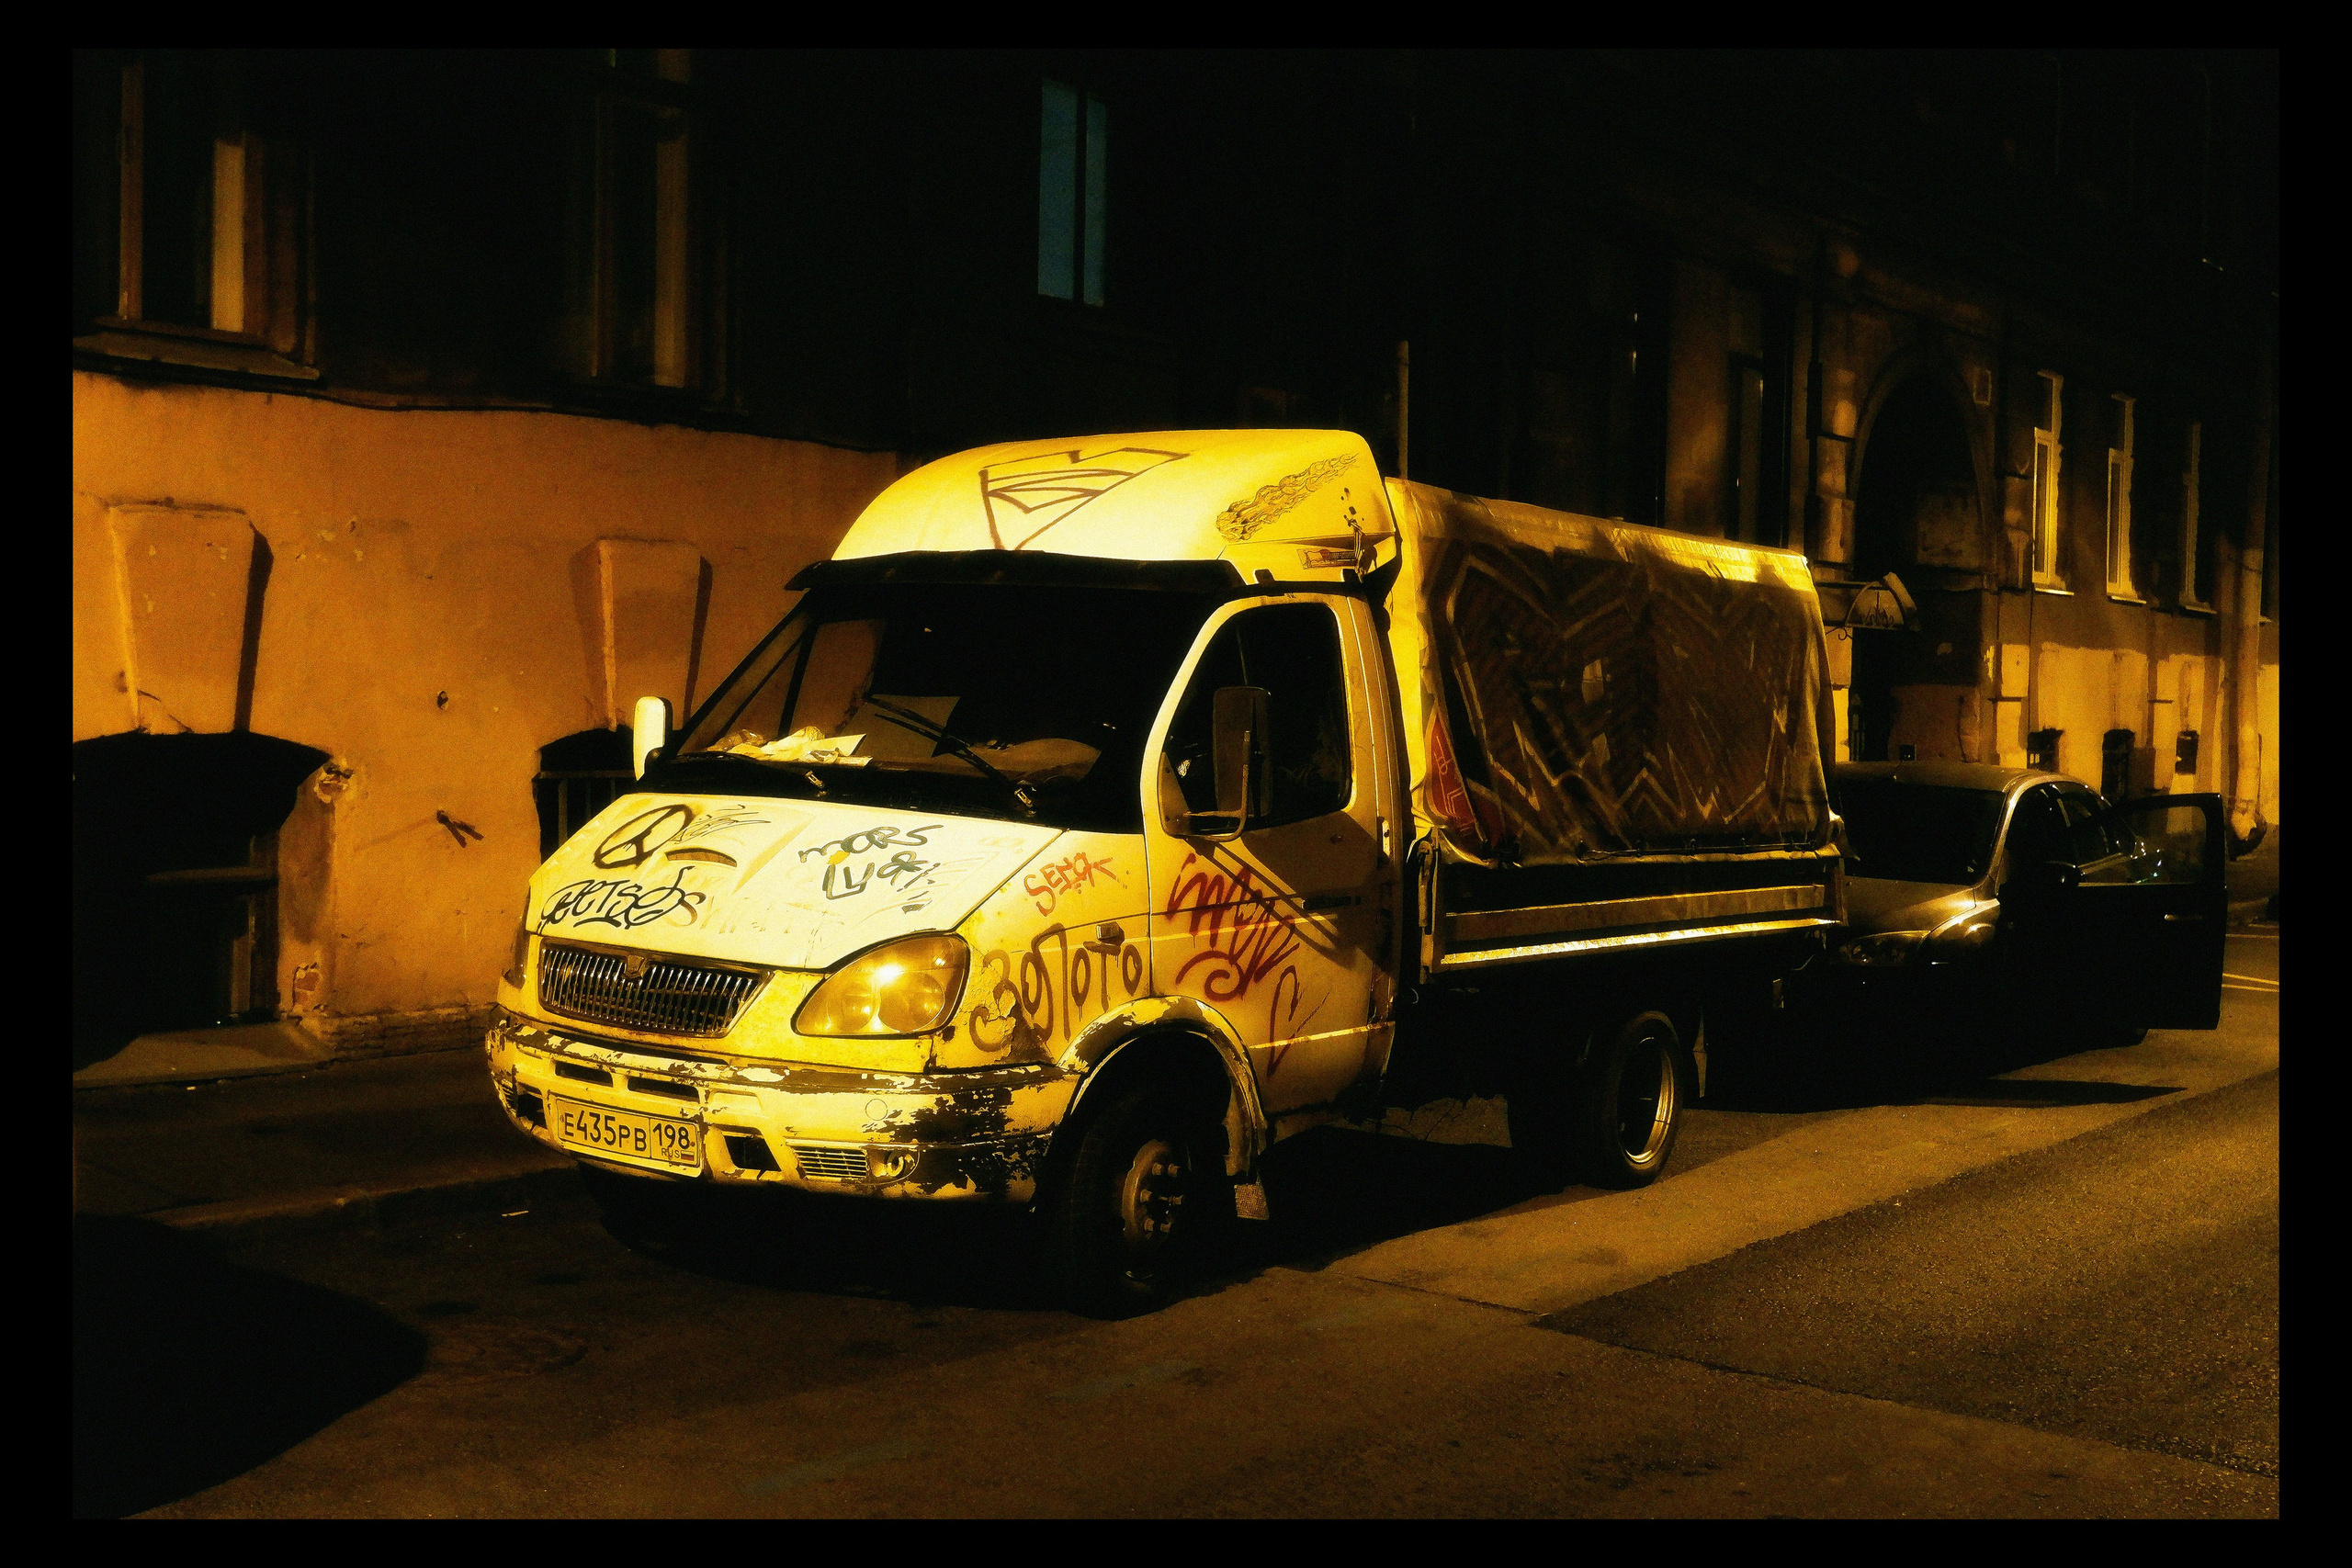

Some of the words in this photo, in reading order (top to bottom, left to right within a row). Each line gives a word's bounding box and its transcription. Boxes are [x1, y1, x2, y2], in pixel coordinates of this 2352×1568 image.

[564, 1110, 647, 1152] E435PB
[652, 1122, 690, 1150] 198
[661, 1147, 681, 1159] RUS
